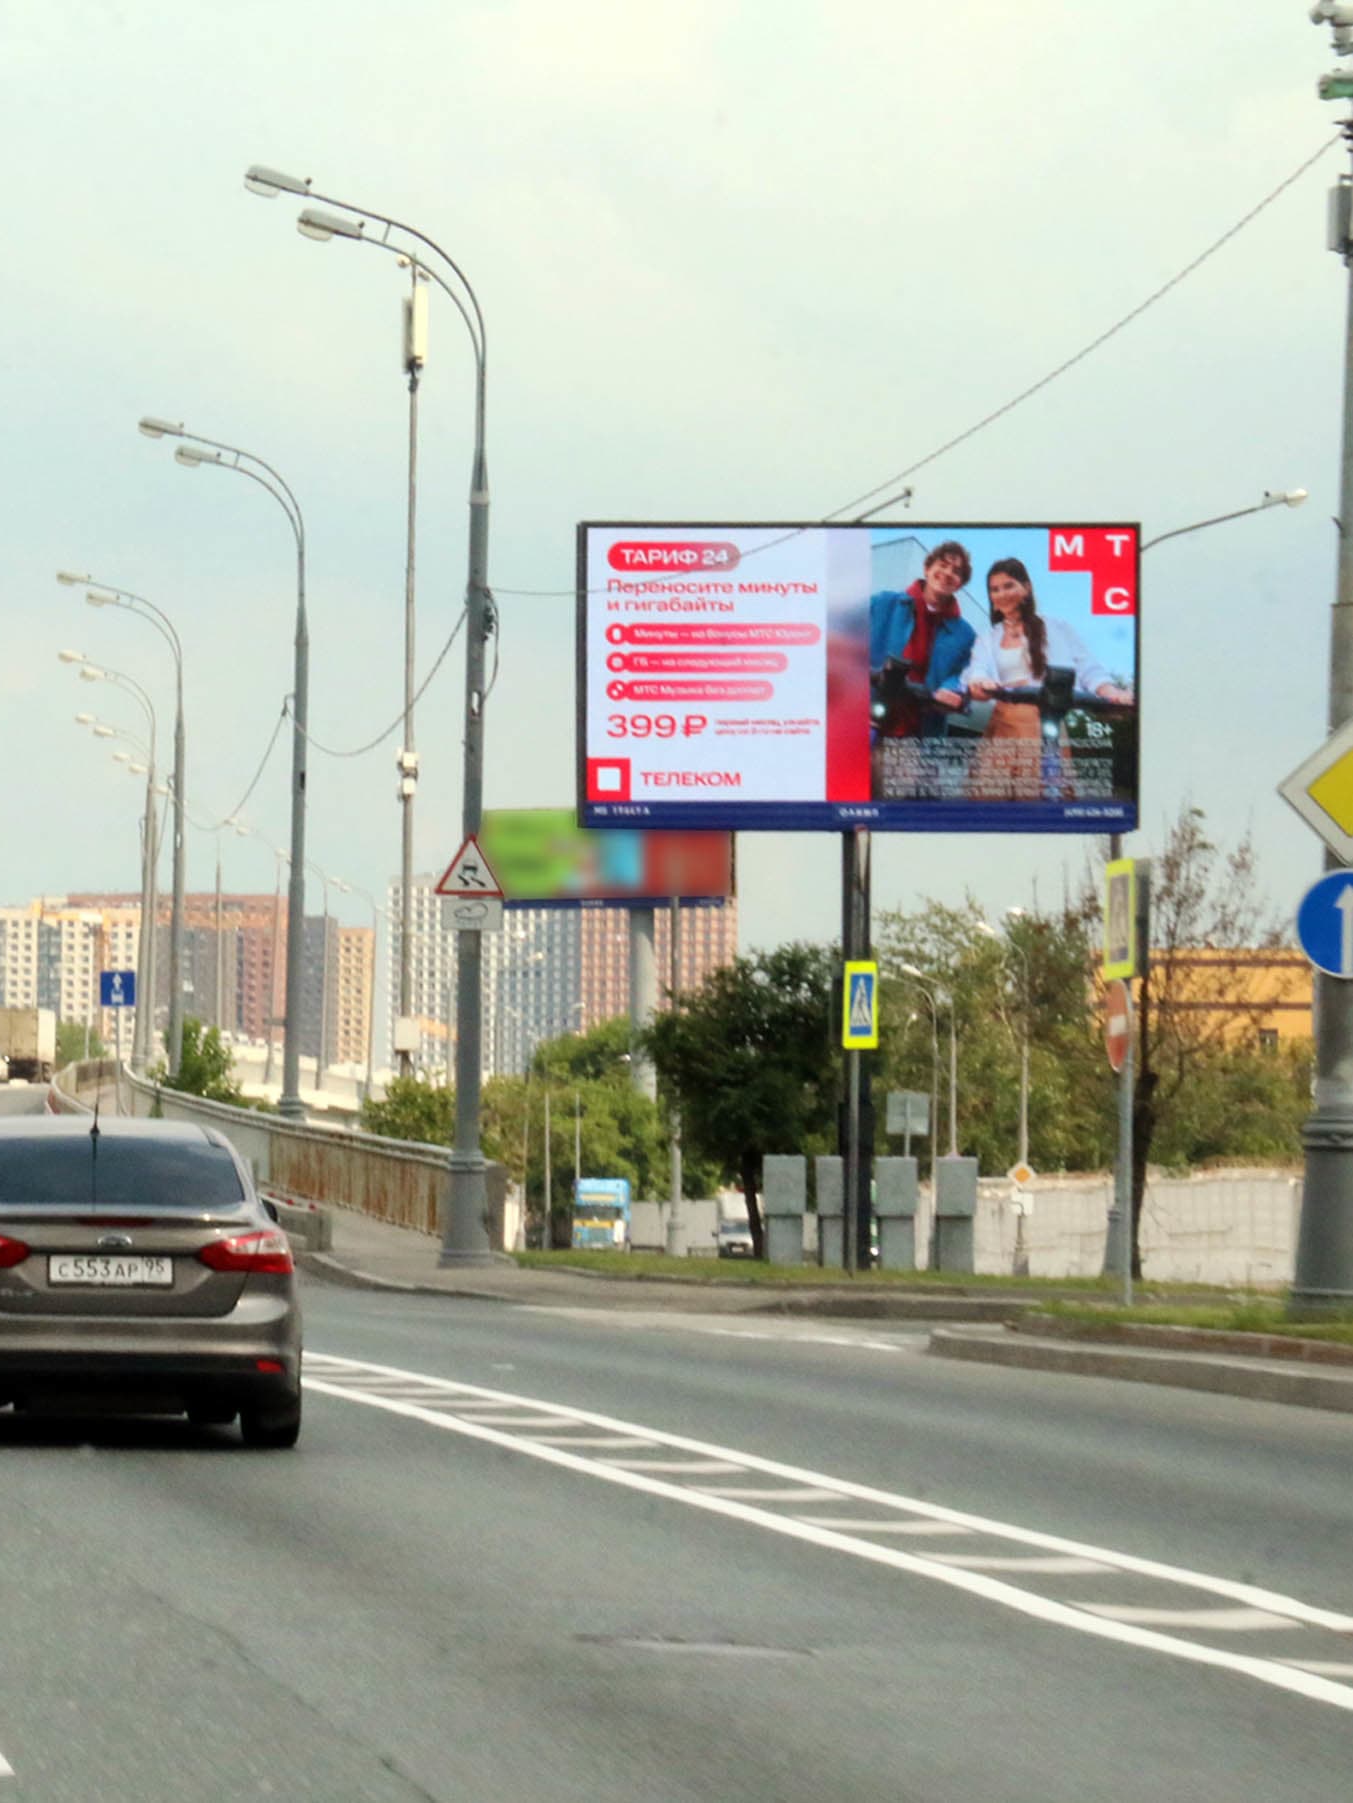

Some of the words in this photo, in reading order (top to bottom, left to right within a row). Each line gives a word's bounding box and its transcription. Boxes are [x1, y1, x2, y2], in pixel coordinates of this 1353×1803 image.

[620, 549, 698, 565] ТАРИФ
[701, 549, 729, 565] 24
[606, 578, 733, 596] Переносите
[738, 581, 818, 596] минуты
[606, 601, 619, 612] и
[624, 596, 735, 612] гигабайты
[606, 714, 677, 739] 399
[640, 771, 742, 787] ТЕЛЕКОМ
